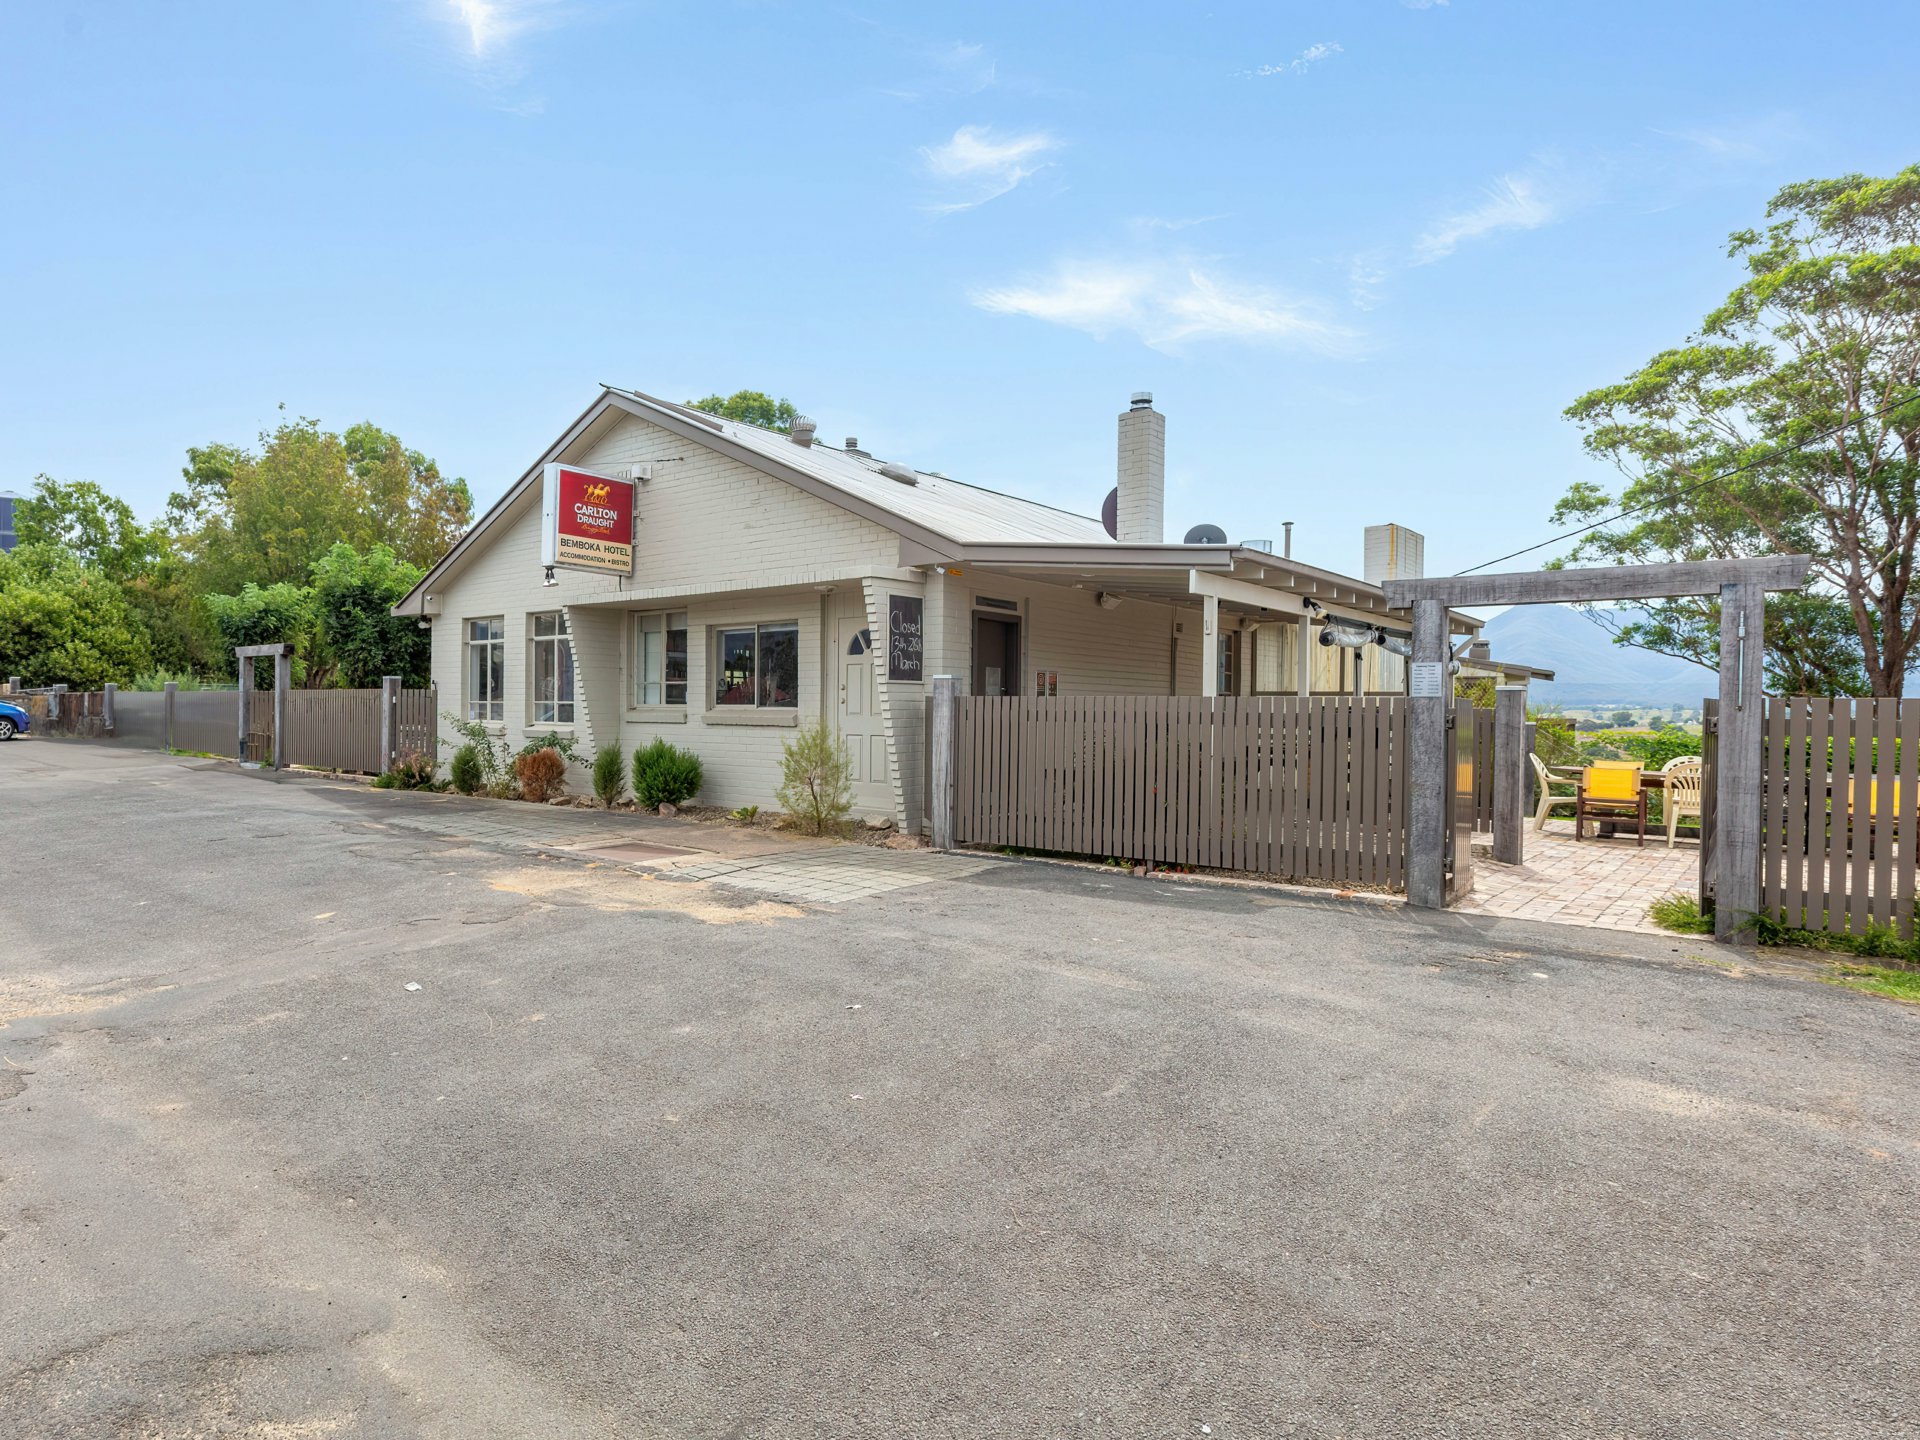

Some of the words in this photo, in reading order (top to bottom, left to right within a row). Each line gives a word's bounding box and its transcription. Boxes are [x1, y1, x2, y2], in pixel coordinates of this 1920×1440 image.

[575, 503, 617, 520] CARLTON
[577, 514, 614, 528] DRAUGHT
[561, 538, 601, 552] BEMBOKA
[604, 545, 630, 556] HOTEL
[560, 552, 606, 563] ACCOMMODATION
[611, 558, 629, 567] BISTRO
[891, 610, 920, 635] Closed
[891, 651, 920, 670] March
